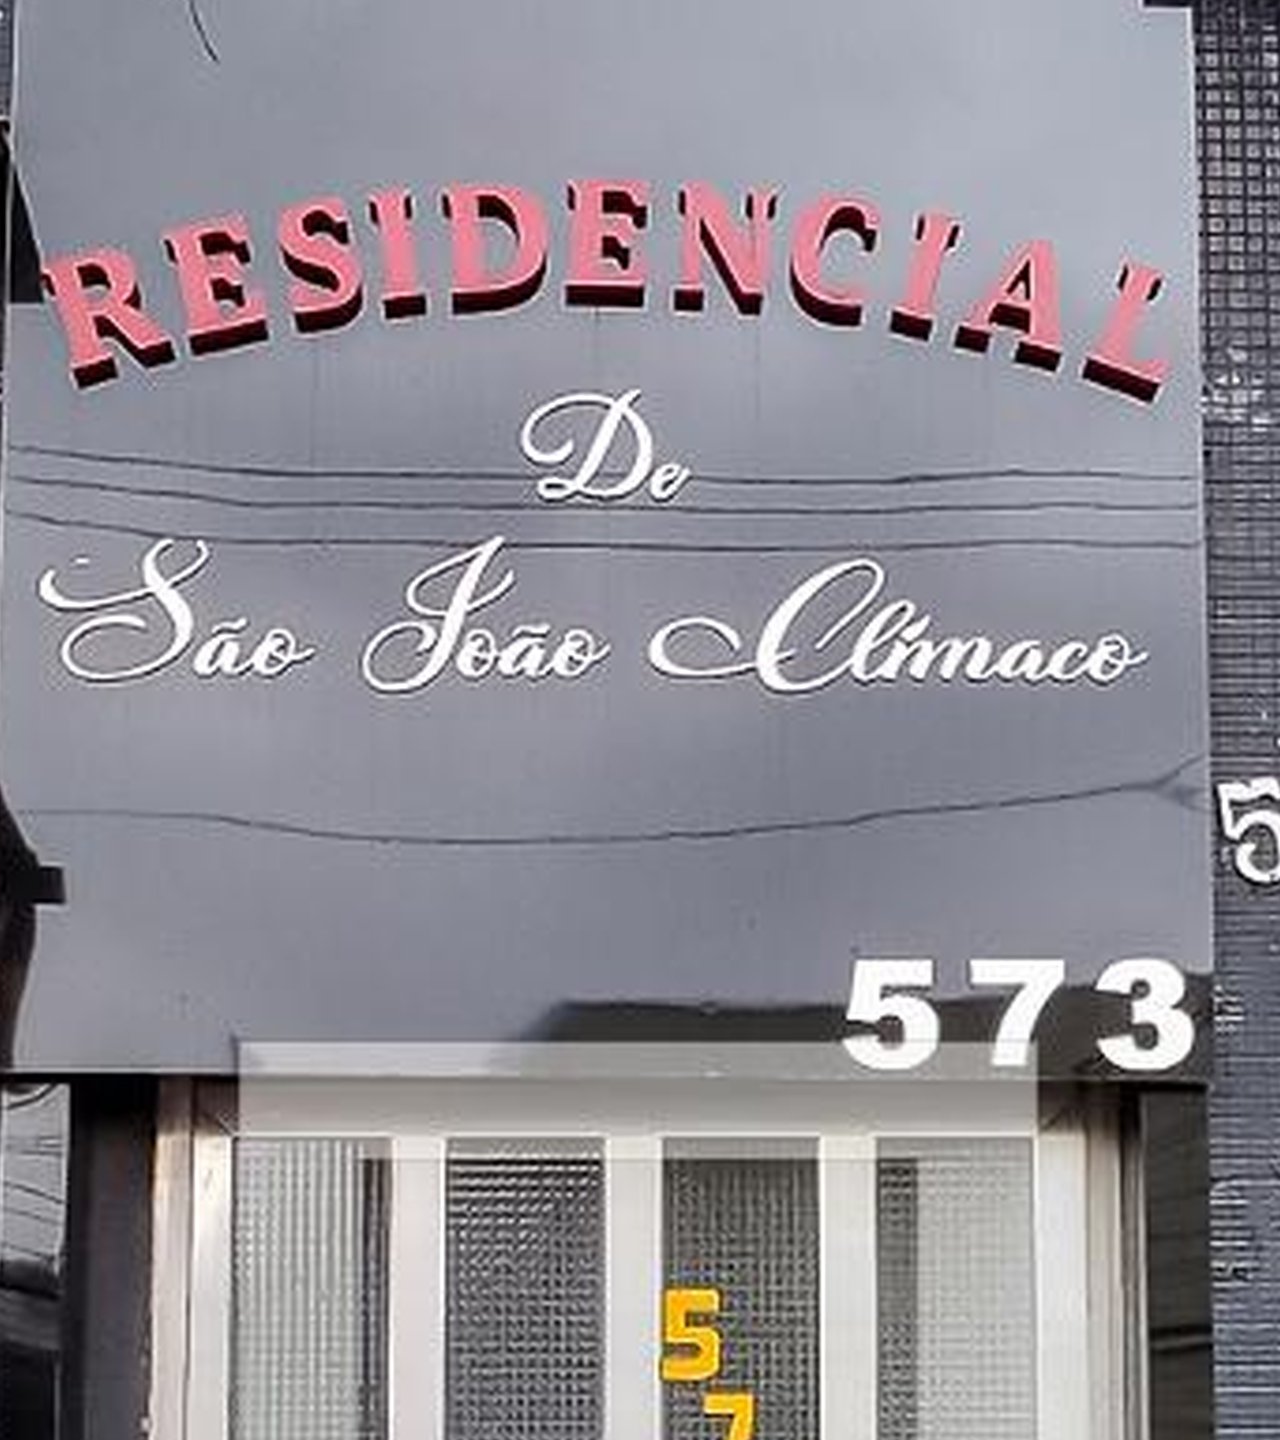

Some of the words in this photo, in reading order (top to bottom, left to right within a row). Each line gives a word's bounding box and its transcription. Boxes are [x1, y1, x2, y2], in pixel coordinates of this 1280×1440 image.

[42, 179, 1170, 403] RESIDENCIAL
[521, 388, 692, 504] De
[37, 538, 314, 683] São
[362, 535, 611, 696] João
[842, 958, 1195, 1072] 573
